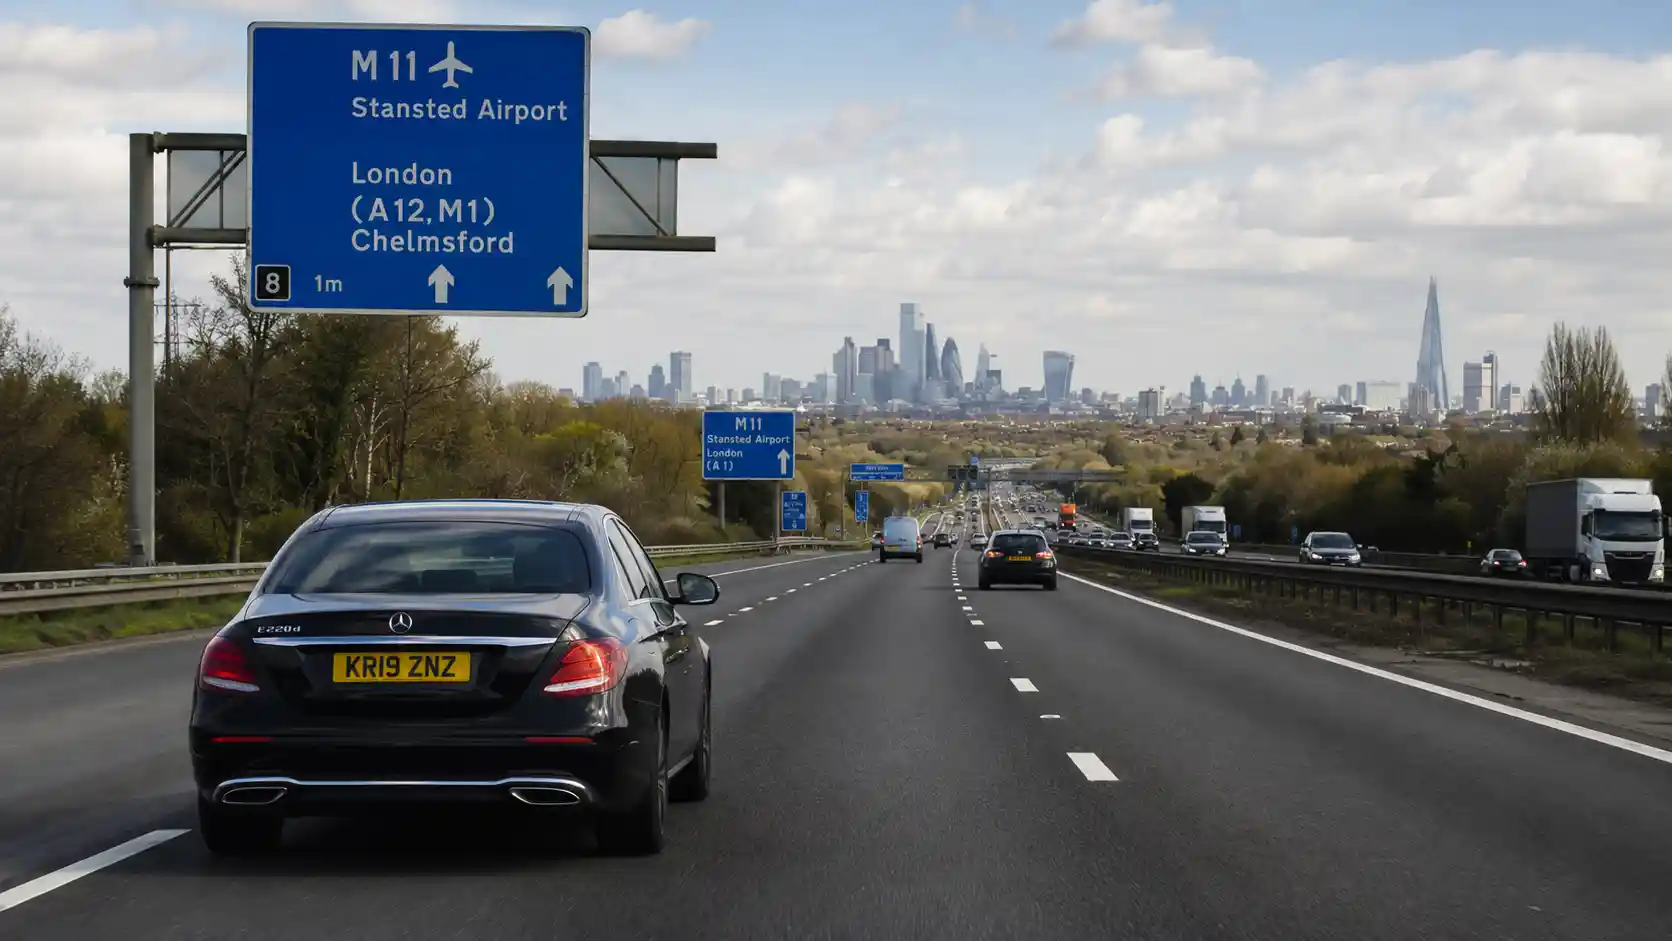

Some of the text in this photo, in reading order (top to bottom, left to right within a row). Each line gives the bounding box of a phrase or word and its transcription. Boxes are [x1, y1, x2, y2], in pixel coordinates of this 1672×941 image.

[351, 97, 568, 125] Stansted Airport
[352, 162, 452, 185] London
[351, 229, 514, 254] Chelmsford
[265, 272, 281, 294] 8
[314, 275, 343, 292] 1m
[707, 434, 790, 445] Stansted Airport
[707, 449, 743, 458] London
[257, 625, 301, 633] E220d
[345, 655, 457, 679] KR19 ZNZ
